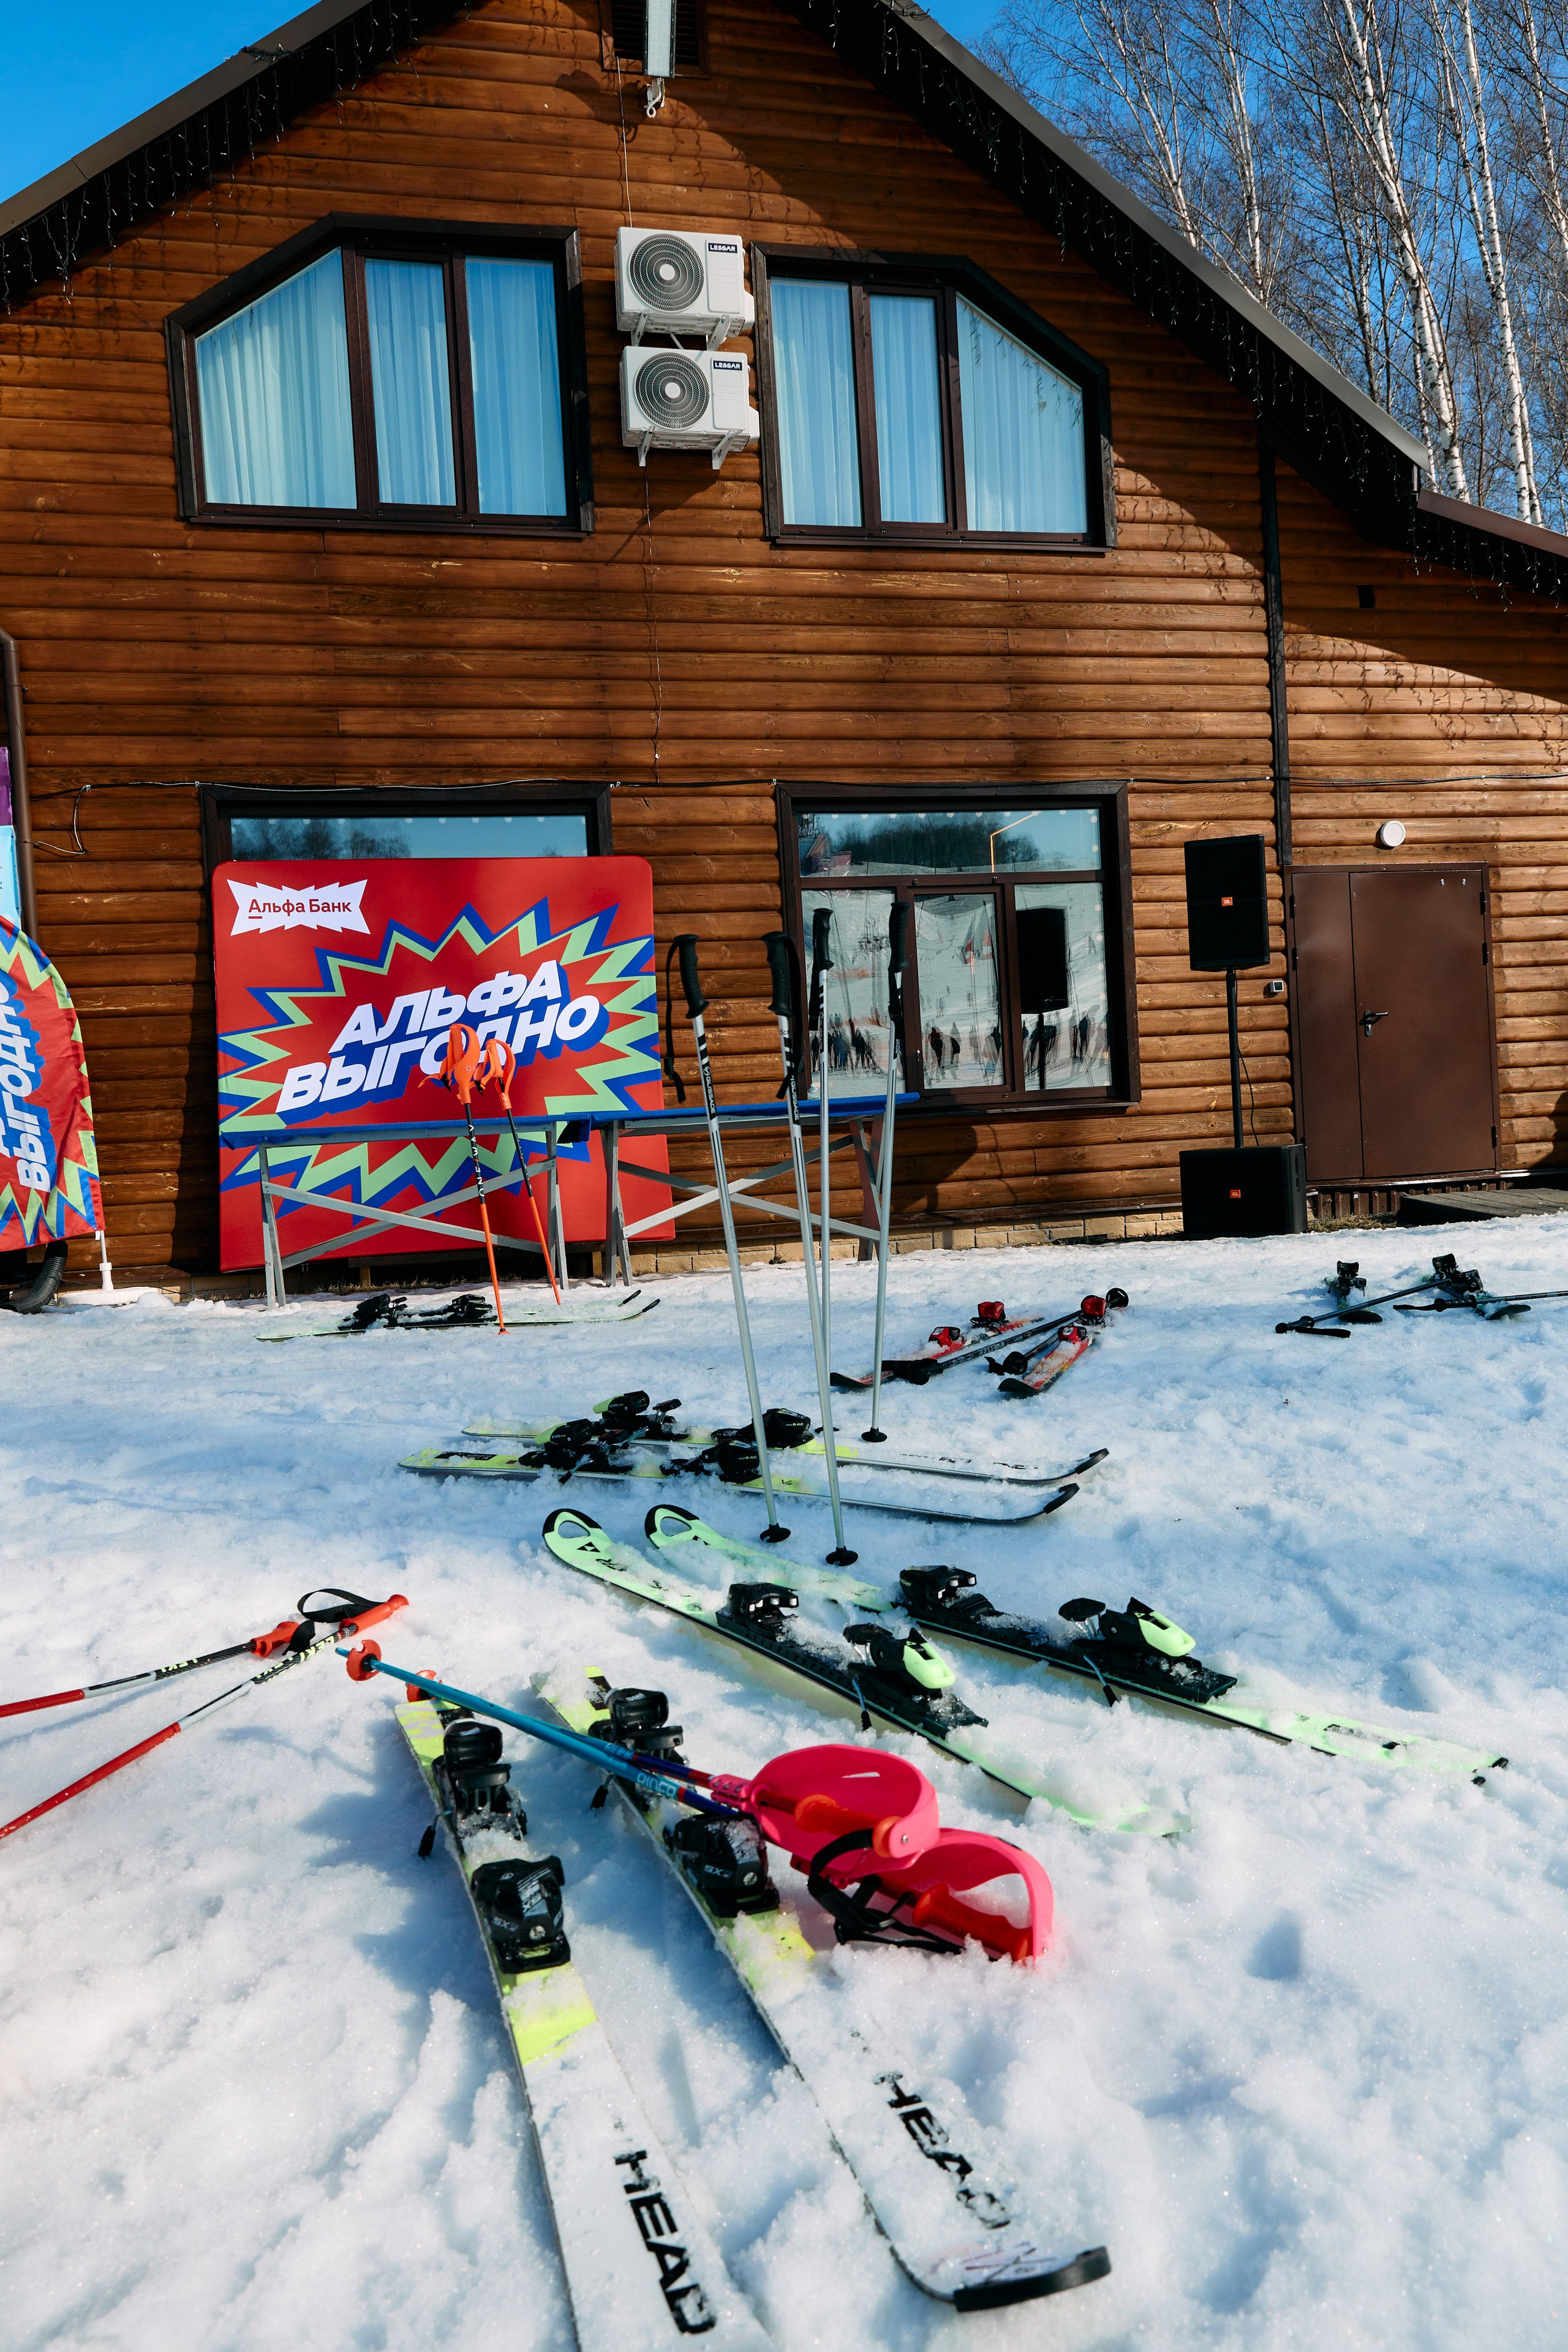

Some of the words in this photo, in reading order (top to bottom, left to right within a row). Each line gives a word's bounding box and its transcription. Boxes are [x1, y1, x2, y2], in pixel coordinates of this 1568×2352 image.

[248, 899, 306, 917] Альфа
[309, 899, 352, 913] Банк
[328, 959, 563, 1054] АЛЬФА
[0, 982, 51, 1193] ВЫГОДН
[706, 1076, 716, 1114] GLISSADE
[791, 1081, 800, 1121] GLISSADE
[299, 1635, 334, 1663] LEKI
[612, 2150, 716, 2334] HEAD
